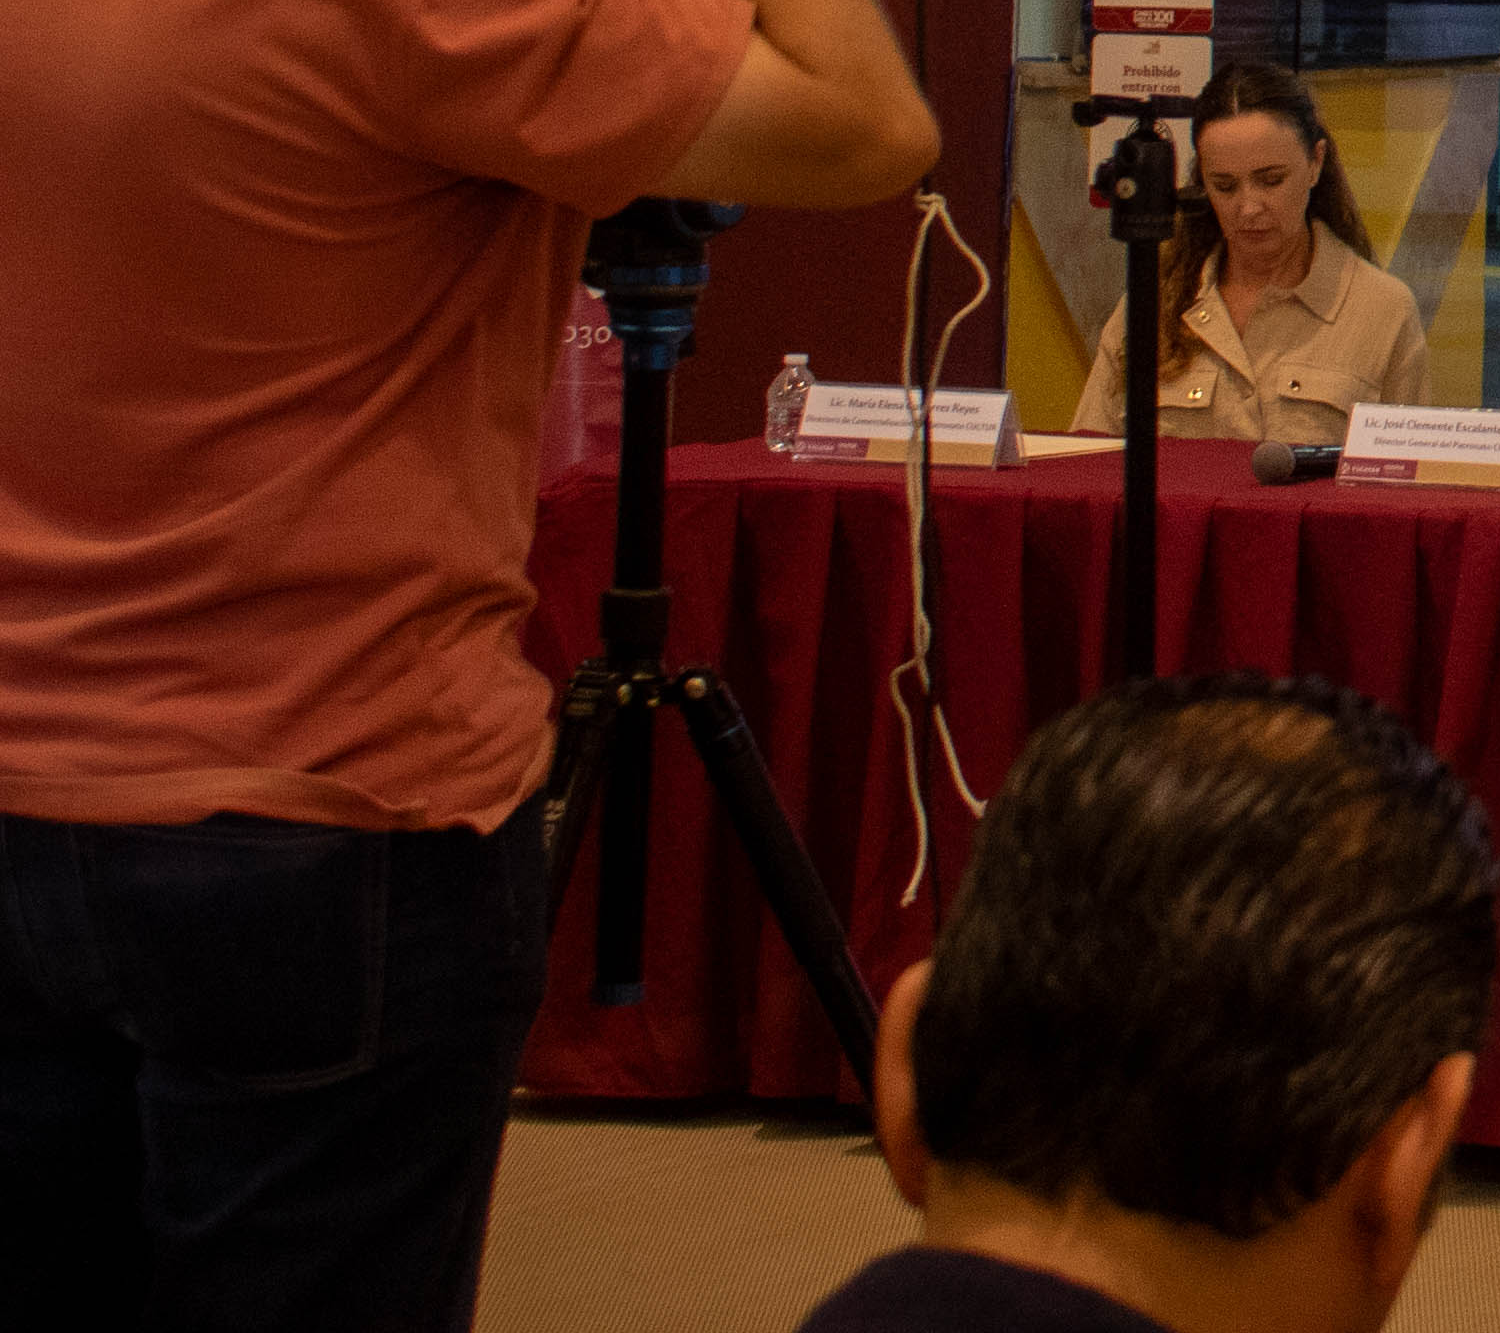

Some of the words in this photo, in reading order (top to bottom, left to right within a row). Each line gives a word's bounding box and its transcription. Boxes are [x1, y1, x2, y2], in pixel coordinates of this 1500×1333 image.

[1123, 65, 1182, 78] Prohibido
[1122, 83, 1158, 93] entrar
[1161, 83, 1182, 94] con
[848, 399, 874, 410] María
[878, 400, 904, 410] Elena
[1364, 417, 1381, 428] Lic.
[1384, 417, 1404, 430] José
[1406, 418, 1454, 431] Clemente
